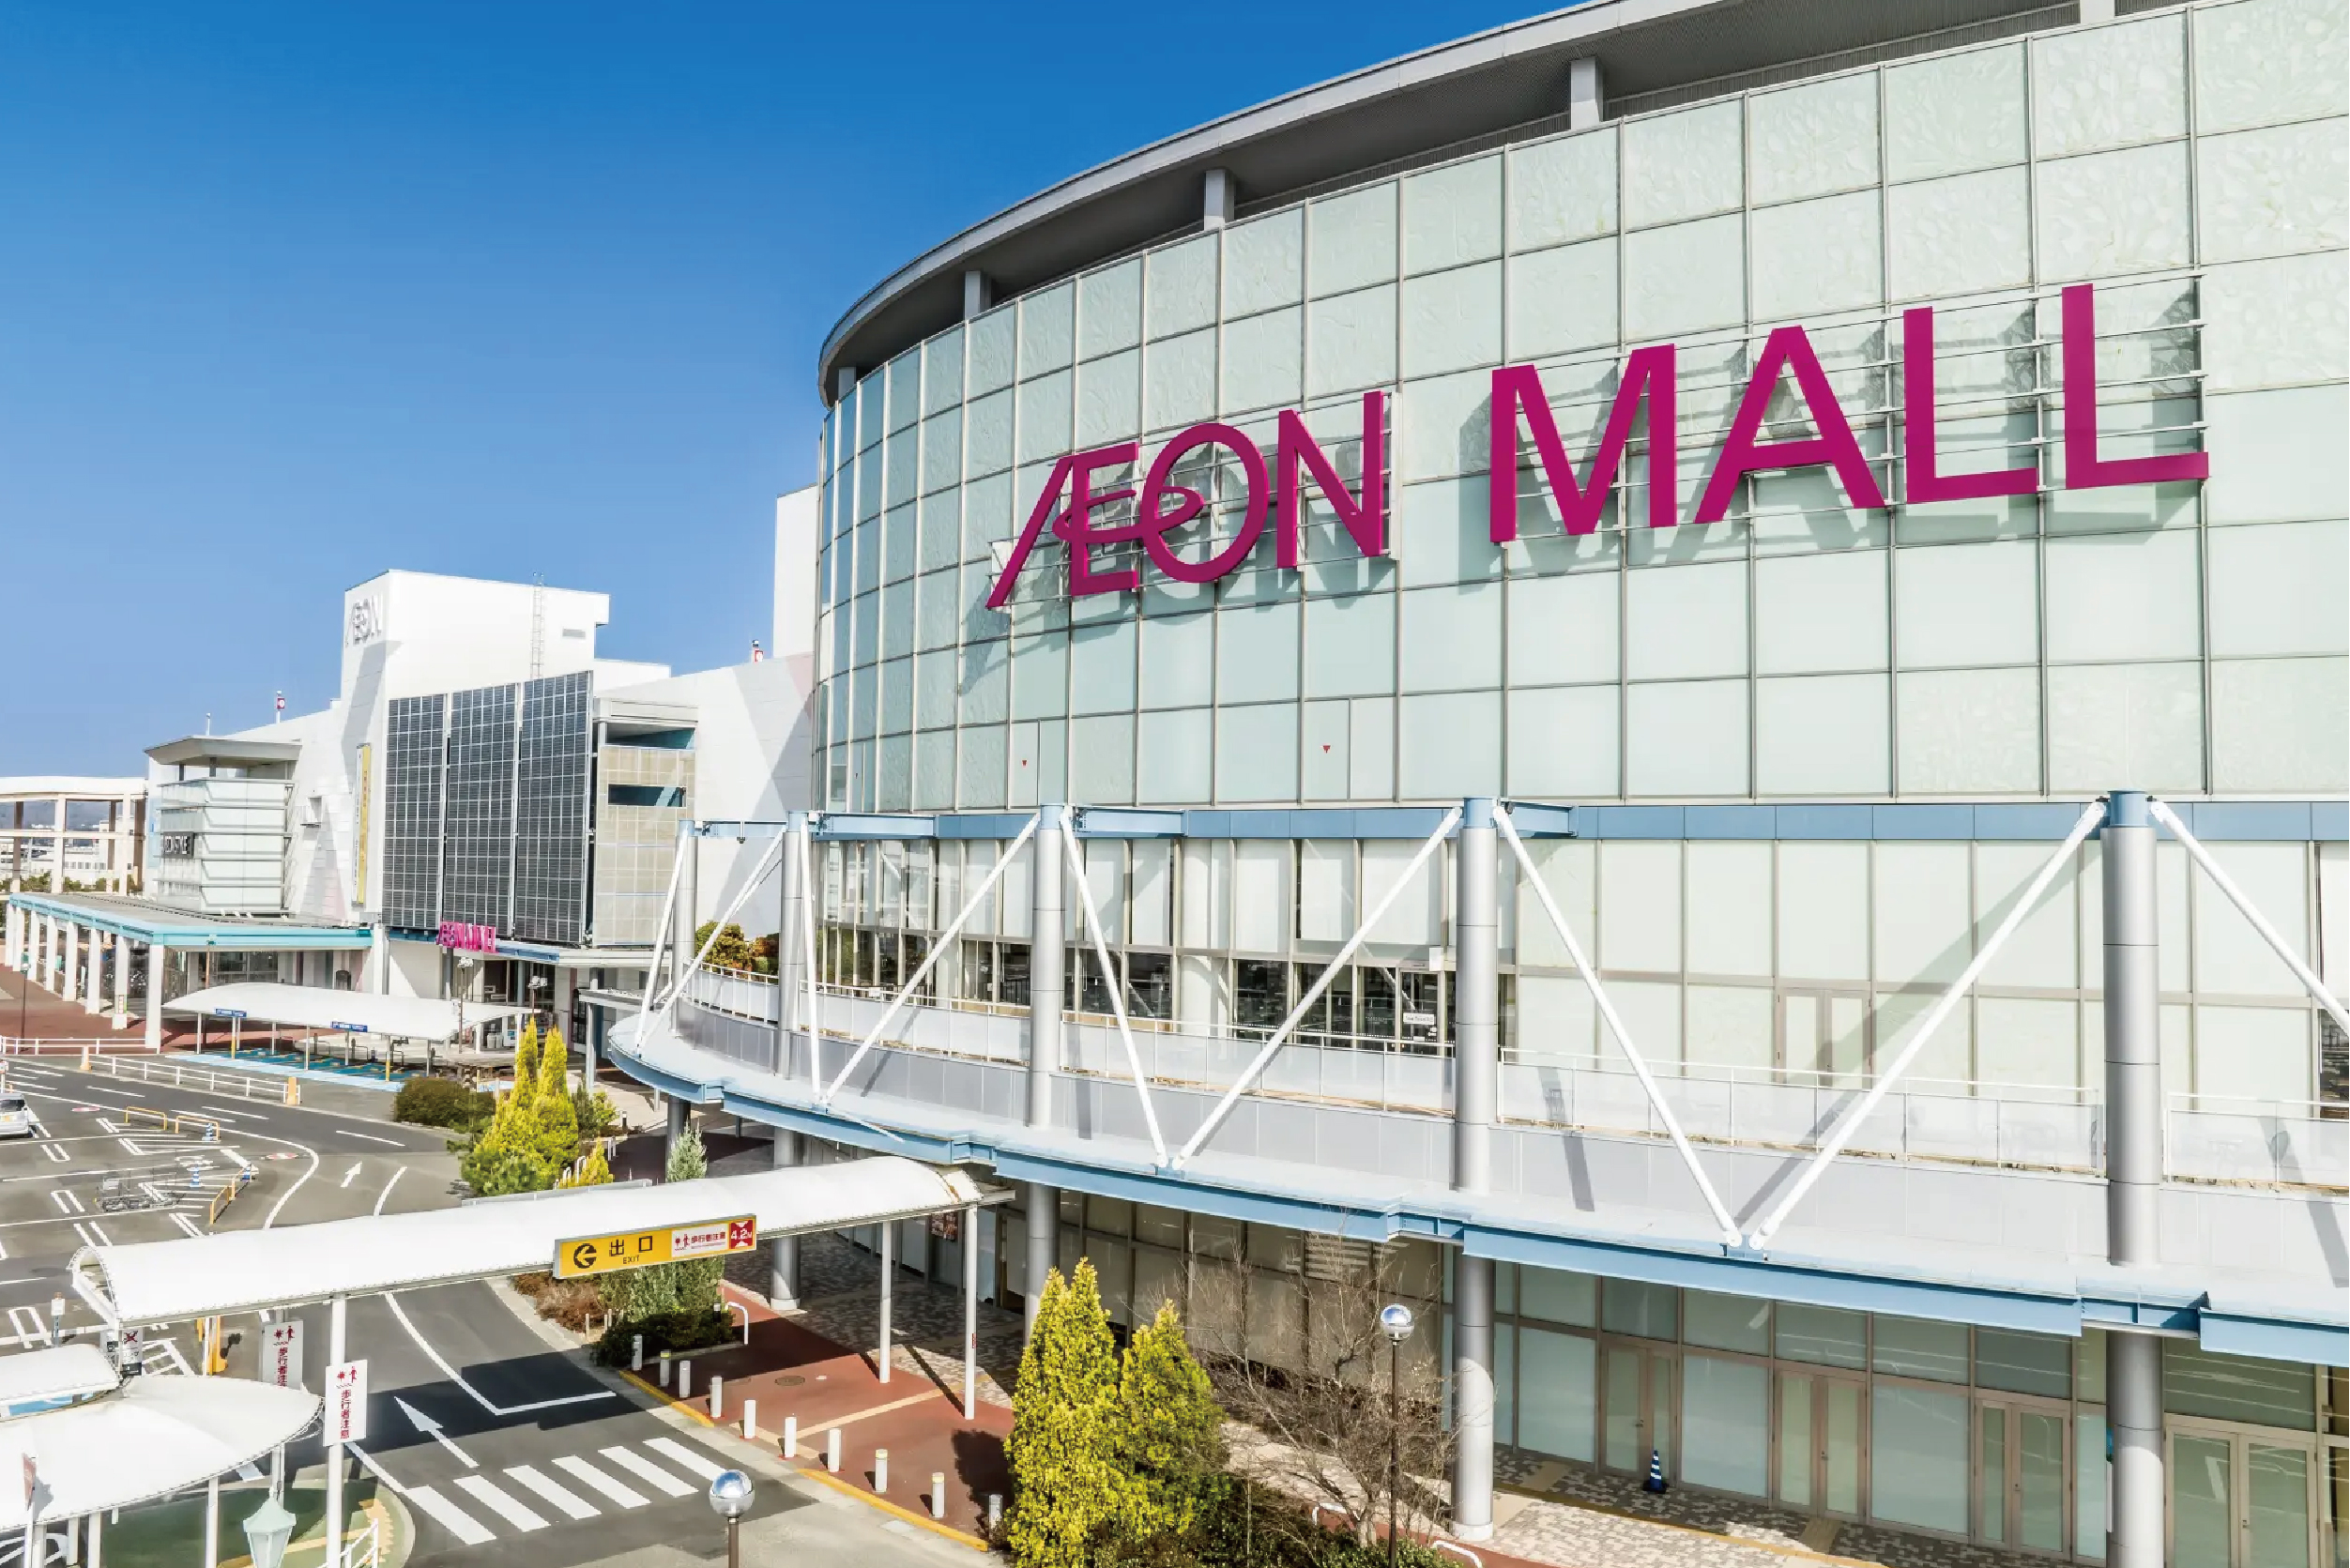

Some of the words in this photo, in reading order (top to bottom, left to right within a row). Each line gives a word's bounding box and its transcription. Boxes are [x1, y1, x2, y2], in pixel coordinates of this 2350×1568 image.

[1490, 283, 2209, 542] MALL
[609, 1236, 652, 1256] 出口
[622, 1255, 640, 1264] EXIT
[278, 1347, 287, 1387] 歩行者注
[341, 1390, 351, 1439] 歩行者注意
